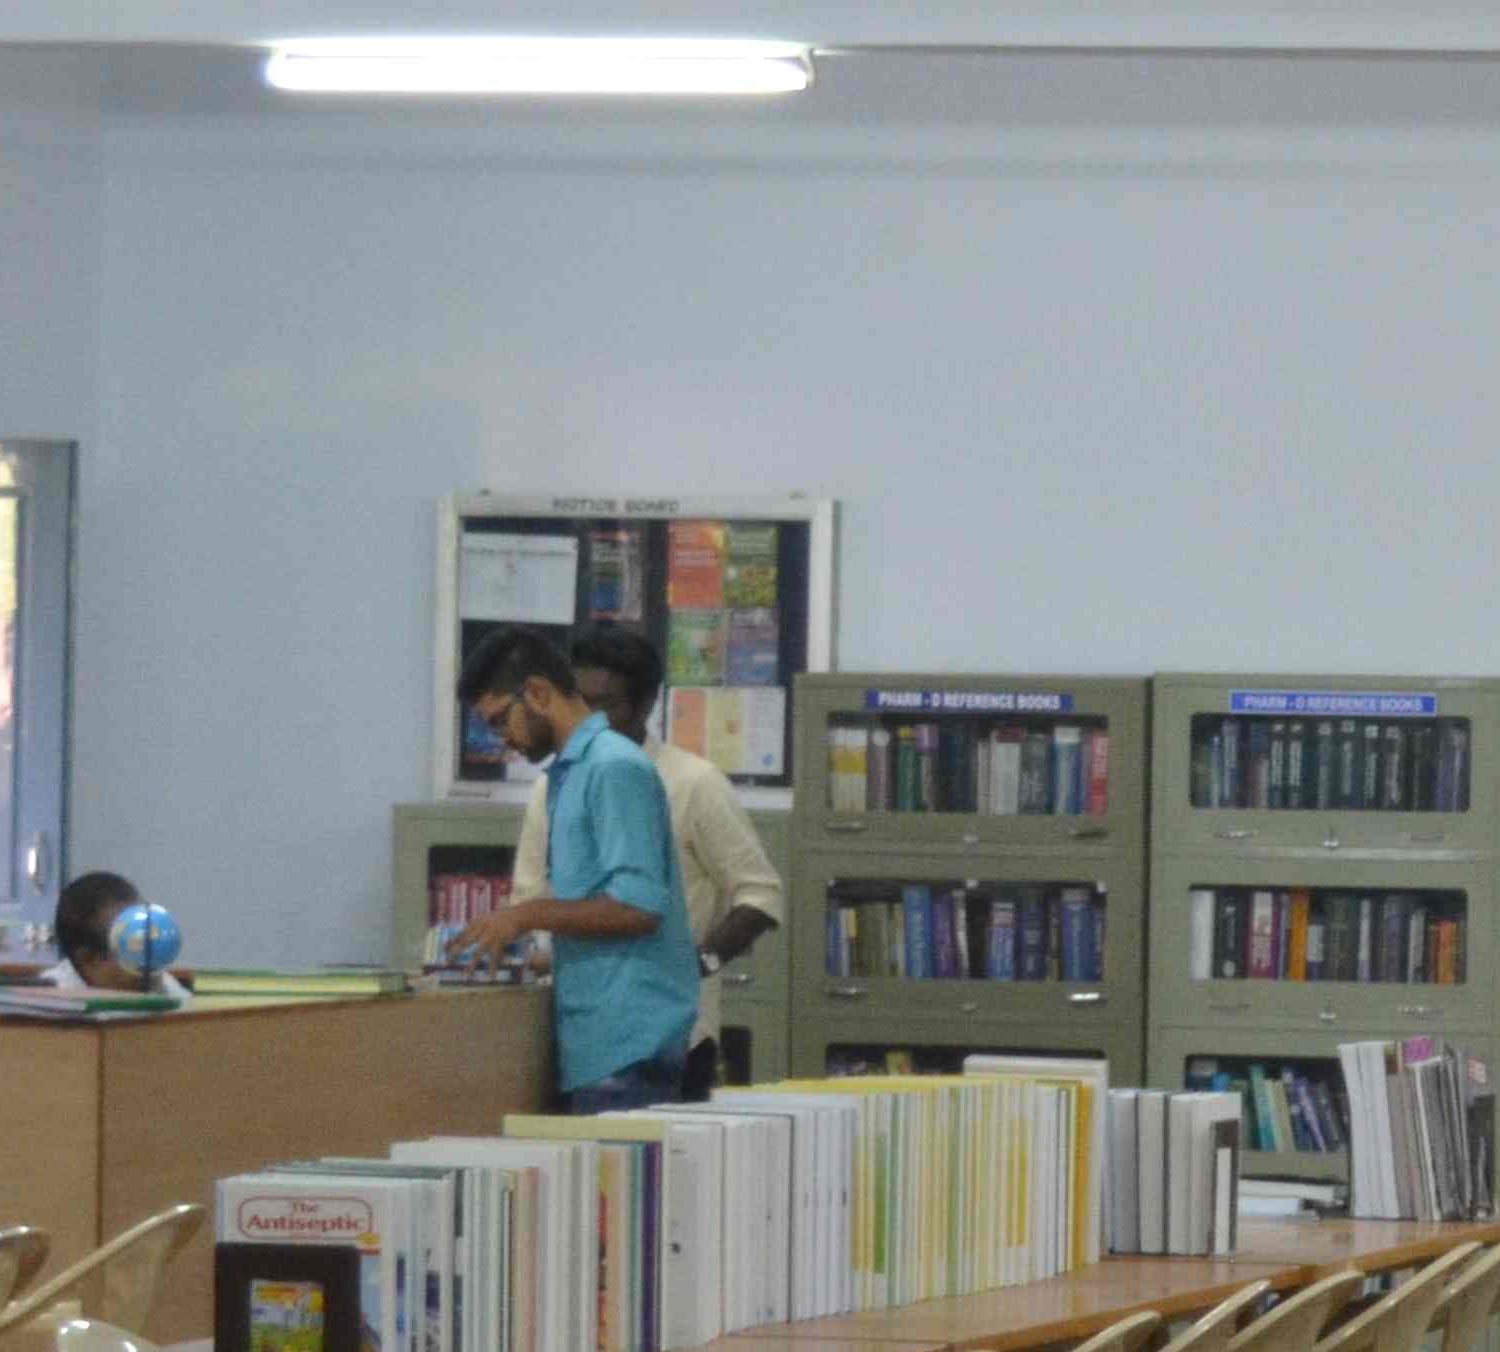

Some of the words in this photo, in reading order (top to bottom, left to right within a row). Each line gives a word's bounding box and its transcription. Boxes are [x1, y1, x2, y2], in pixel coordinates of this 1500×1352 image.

[552, 497, 616, 513] NOTICE
[626, 497, 679, 513] BOARD
[878, 691, 922, 707] PHARM
[944, 692, 1014, 709] REFERENCE
[1017, 694, 1061, 710] BOOKS
[1244, 694, 1285, 709] PHARM
[1307, 696, 1376, 711] REFERENCE
[1380, 698, 1422, 713] BOOKS
[292, 1200, 319, 1212] The
[247, 1214, 365, 1232] Antiseptic
